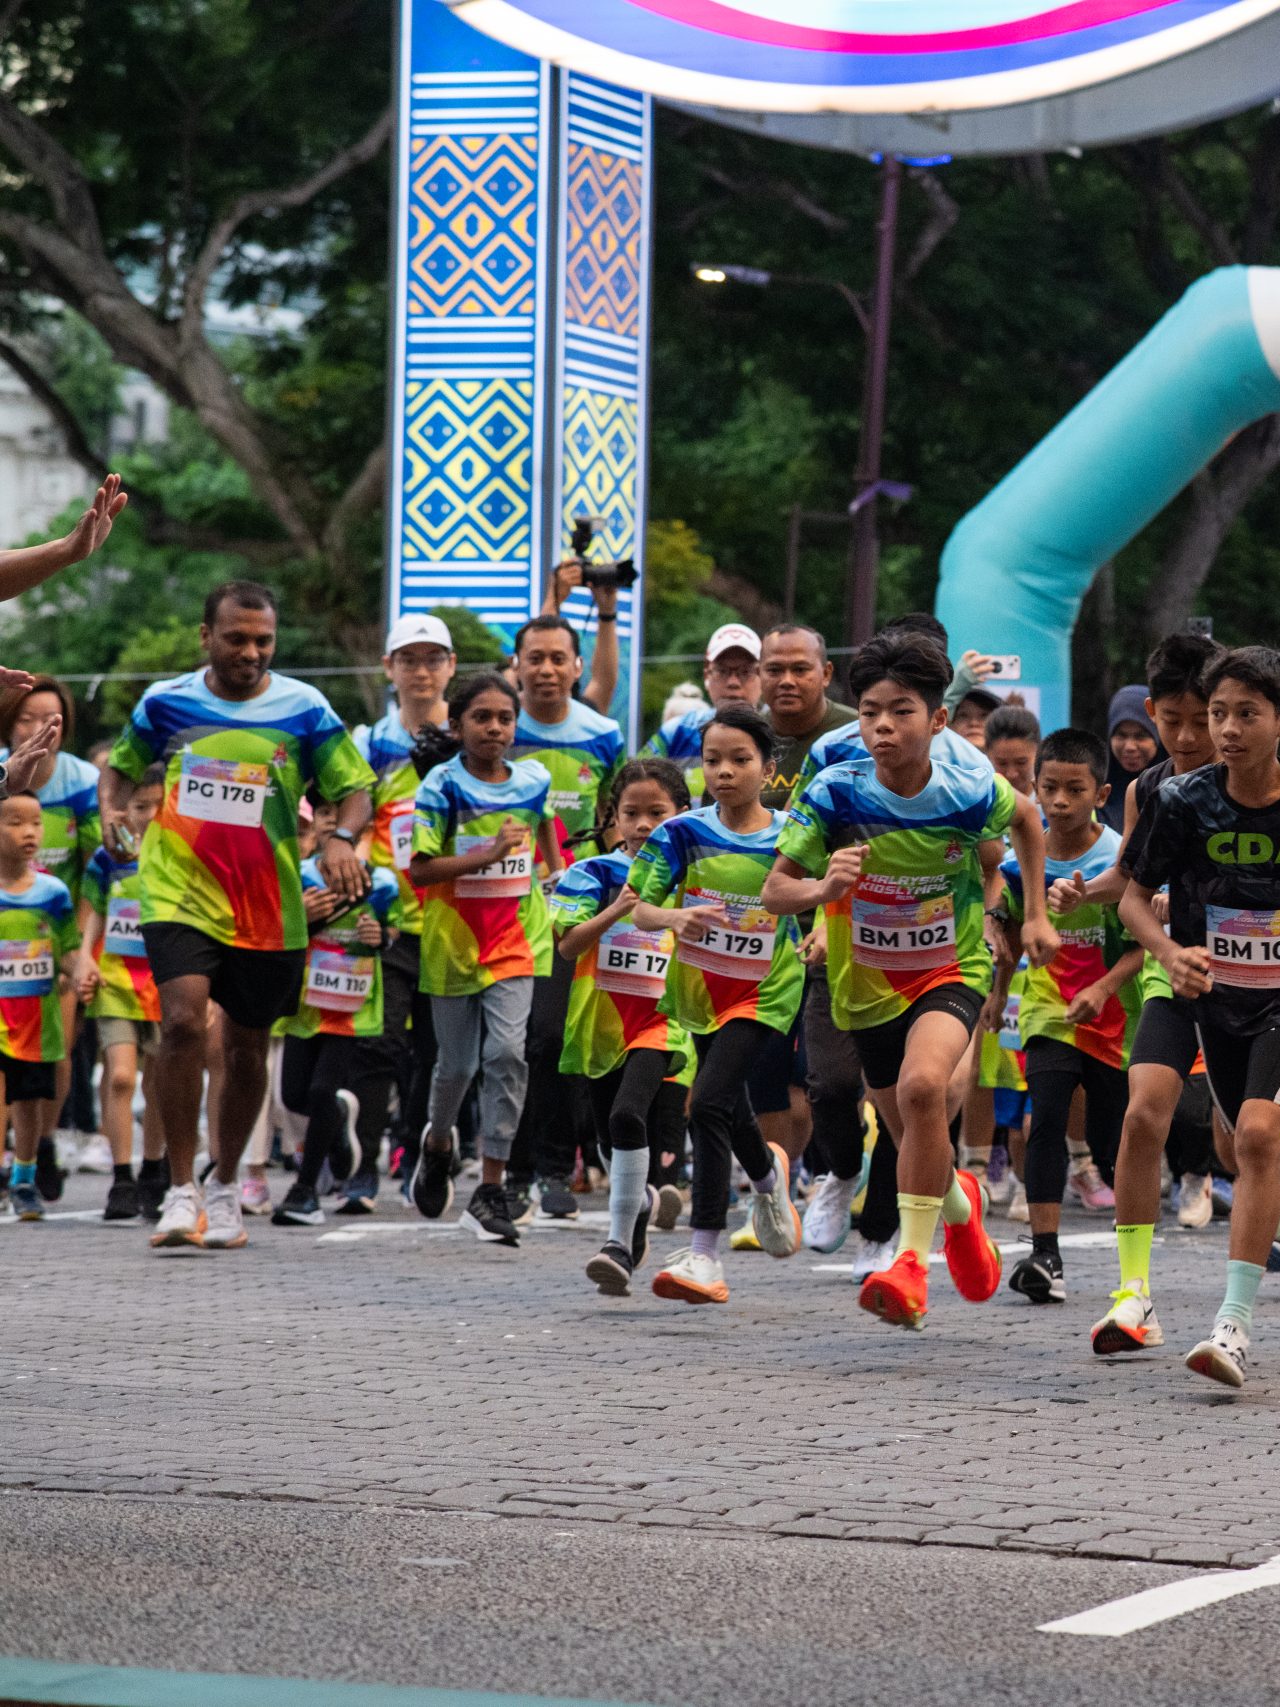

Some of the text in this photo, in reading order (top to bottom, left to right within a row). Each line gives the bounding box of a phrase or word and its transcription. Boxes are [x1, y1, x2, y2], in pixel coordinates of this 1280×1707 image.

[187, 779, 214, 798] PG
[221, 785, 256, 804] 178
[501, 858, 525, 875] 178
[866, 873, 946, 886] MALAYSIA
[701, 888, 762, 904] MALAYSIA
[724, 933, 763, 955] 179
[859, 925, 949, 948] BM 102
[1213, 936, 1252, 960] BM
[0, 961, 49, 977] M 013
[608, 949, 639, 969] BF
[646, 955, 668, 973] 17
[314, 972, 368, 992] BM 110
